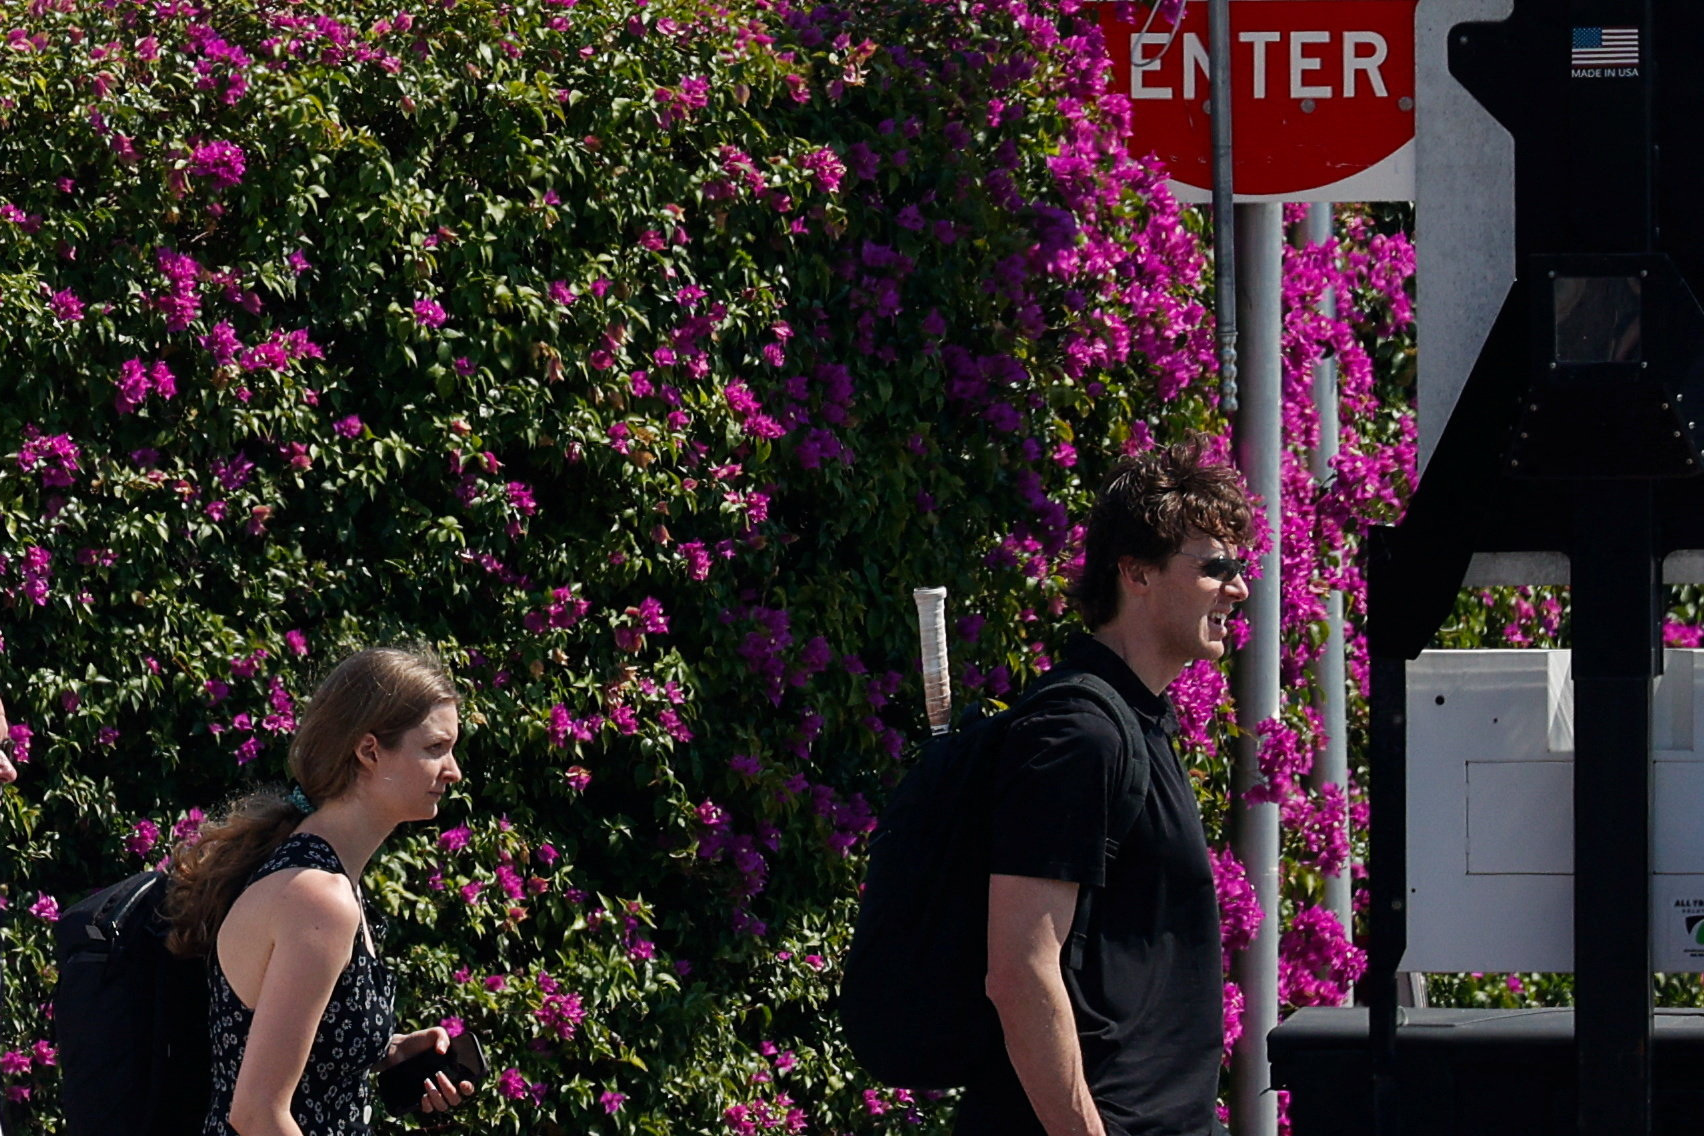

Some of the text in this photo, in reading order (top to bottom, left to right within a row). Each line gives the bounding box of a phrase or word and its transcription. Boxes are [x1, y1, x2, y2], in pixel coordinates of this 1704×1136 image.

[1130, 31, 1388, 99] ENTER
[1571, 67, 1639, 78] MADE IN USA
